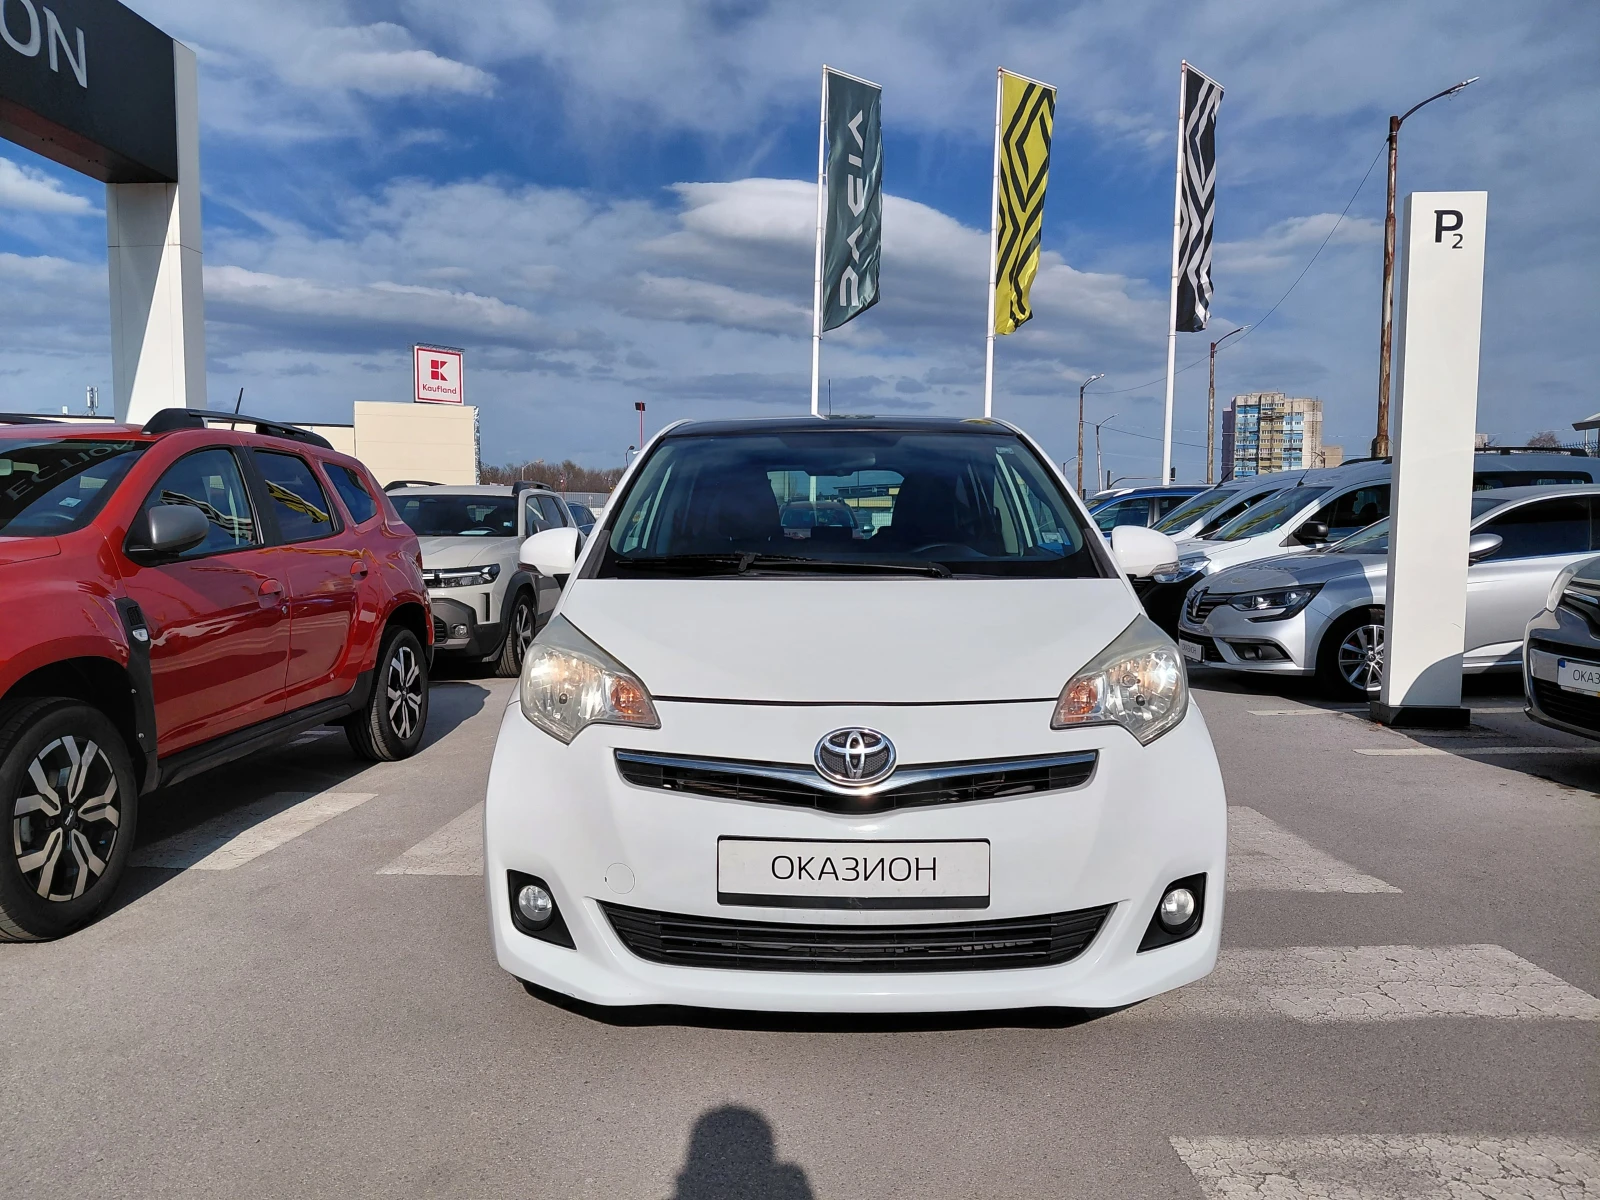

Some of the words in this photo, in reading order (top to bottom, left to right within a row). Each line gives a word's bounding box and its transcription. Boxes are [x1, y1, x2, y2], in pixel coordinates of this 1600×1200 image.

[839, 110, 864, 307] DACIA
[422, 383, 457, 395] Kaufland
[771, 855, 937, 882] ОКАЗИОН
